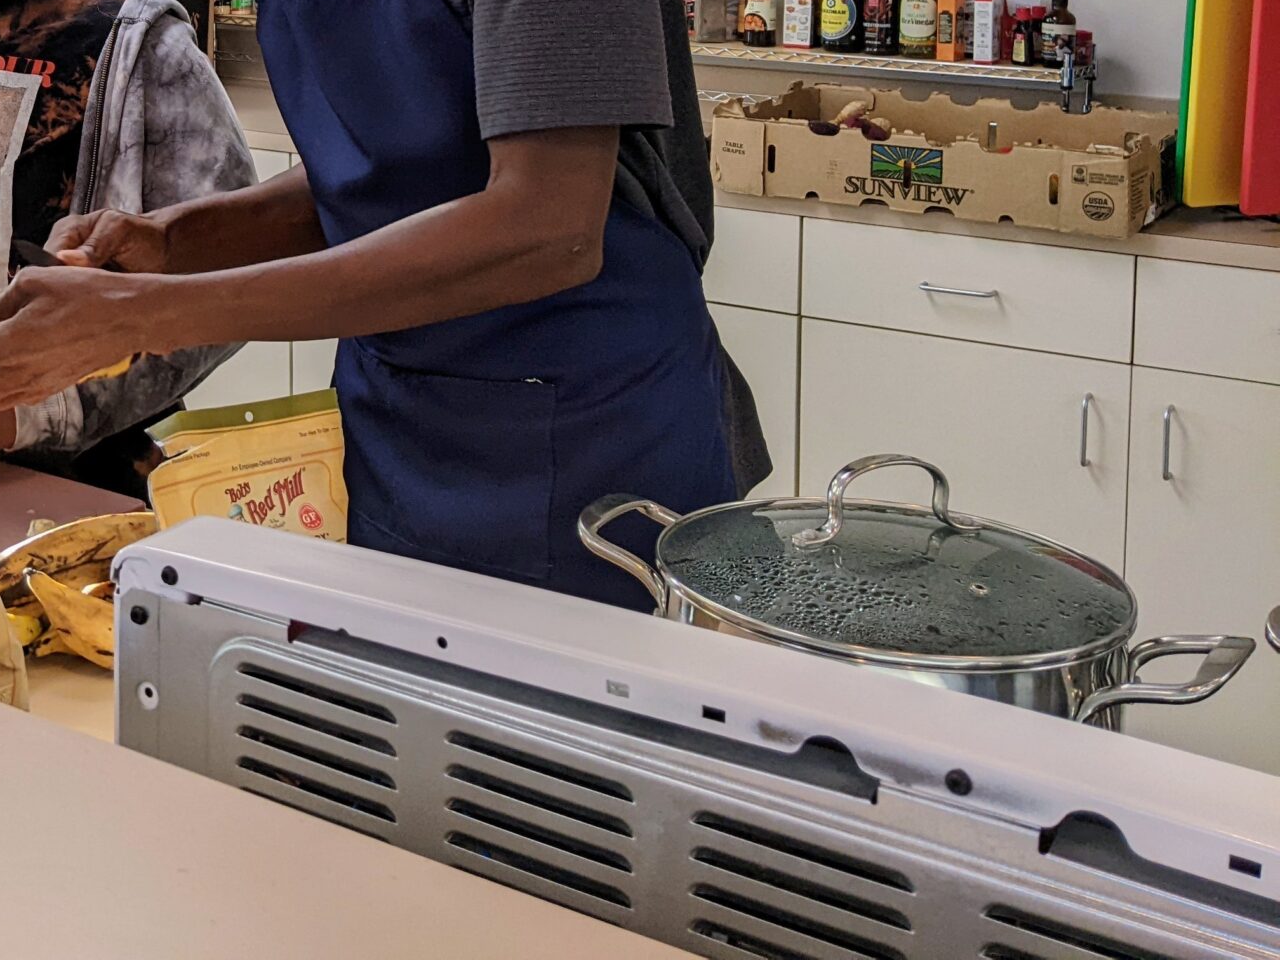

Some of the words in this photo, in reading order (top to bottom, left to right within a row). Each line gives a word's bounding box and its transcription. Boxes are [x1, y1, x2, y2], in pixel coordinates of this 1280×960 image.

[725, 140, 744, 149] TABLE
[722, 146, 746, 155] GRAPES
[844, 175, 970, 206] SUNVIEW
[1088, 197, 1108, 205] USDA
[274, 456, 292, 464] Company
[224, 481, 252, 503] Bob's
[245, 484, 276, 525] Red
[273, 467, 304, 517] Mill
[302, 511, 316, 524] GF
